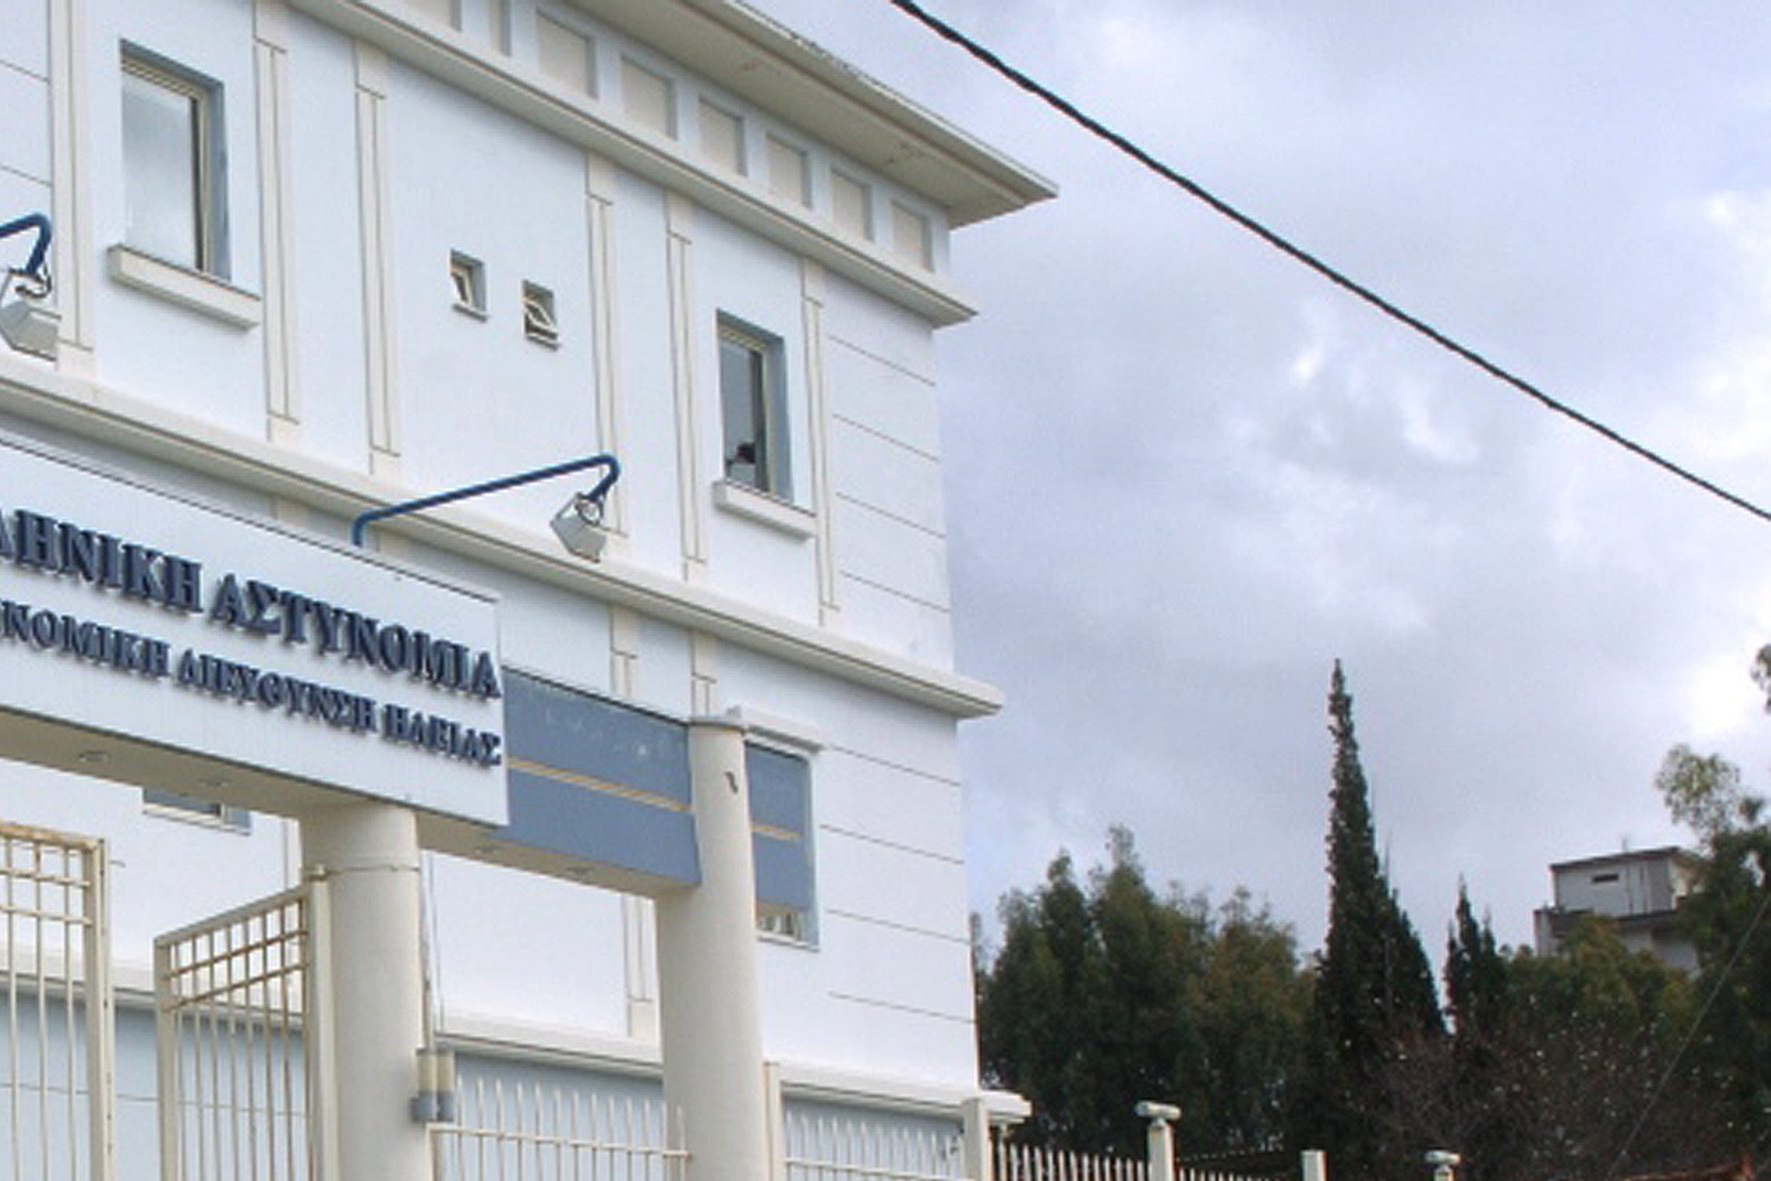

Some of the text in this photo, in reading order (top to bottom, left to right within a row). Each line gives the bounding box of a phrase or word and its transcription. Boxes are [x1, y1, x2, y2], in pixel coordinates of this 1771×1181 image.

[209, 572, 502, 698] ΑΣΤΥΝΟΜΙΑ
[178, 649, 377, 734] ΔΙΕΥΘΥΝΣΗ
[384, 703, 501, 768] ΗΛΕΙΑΣ
